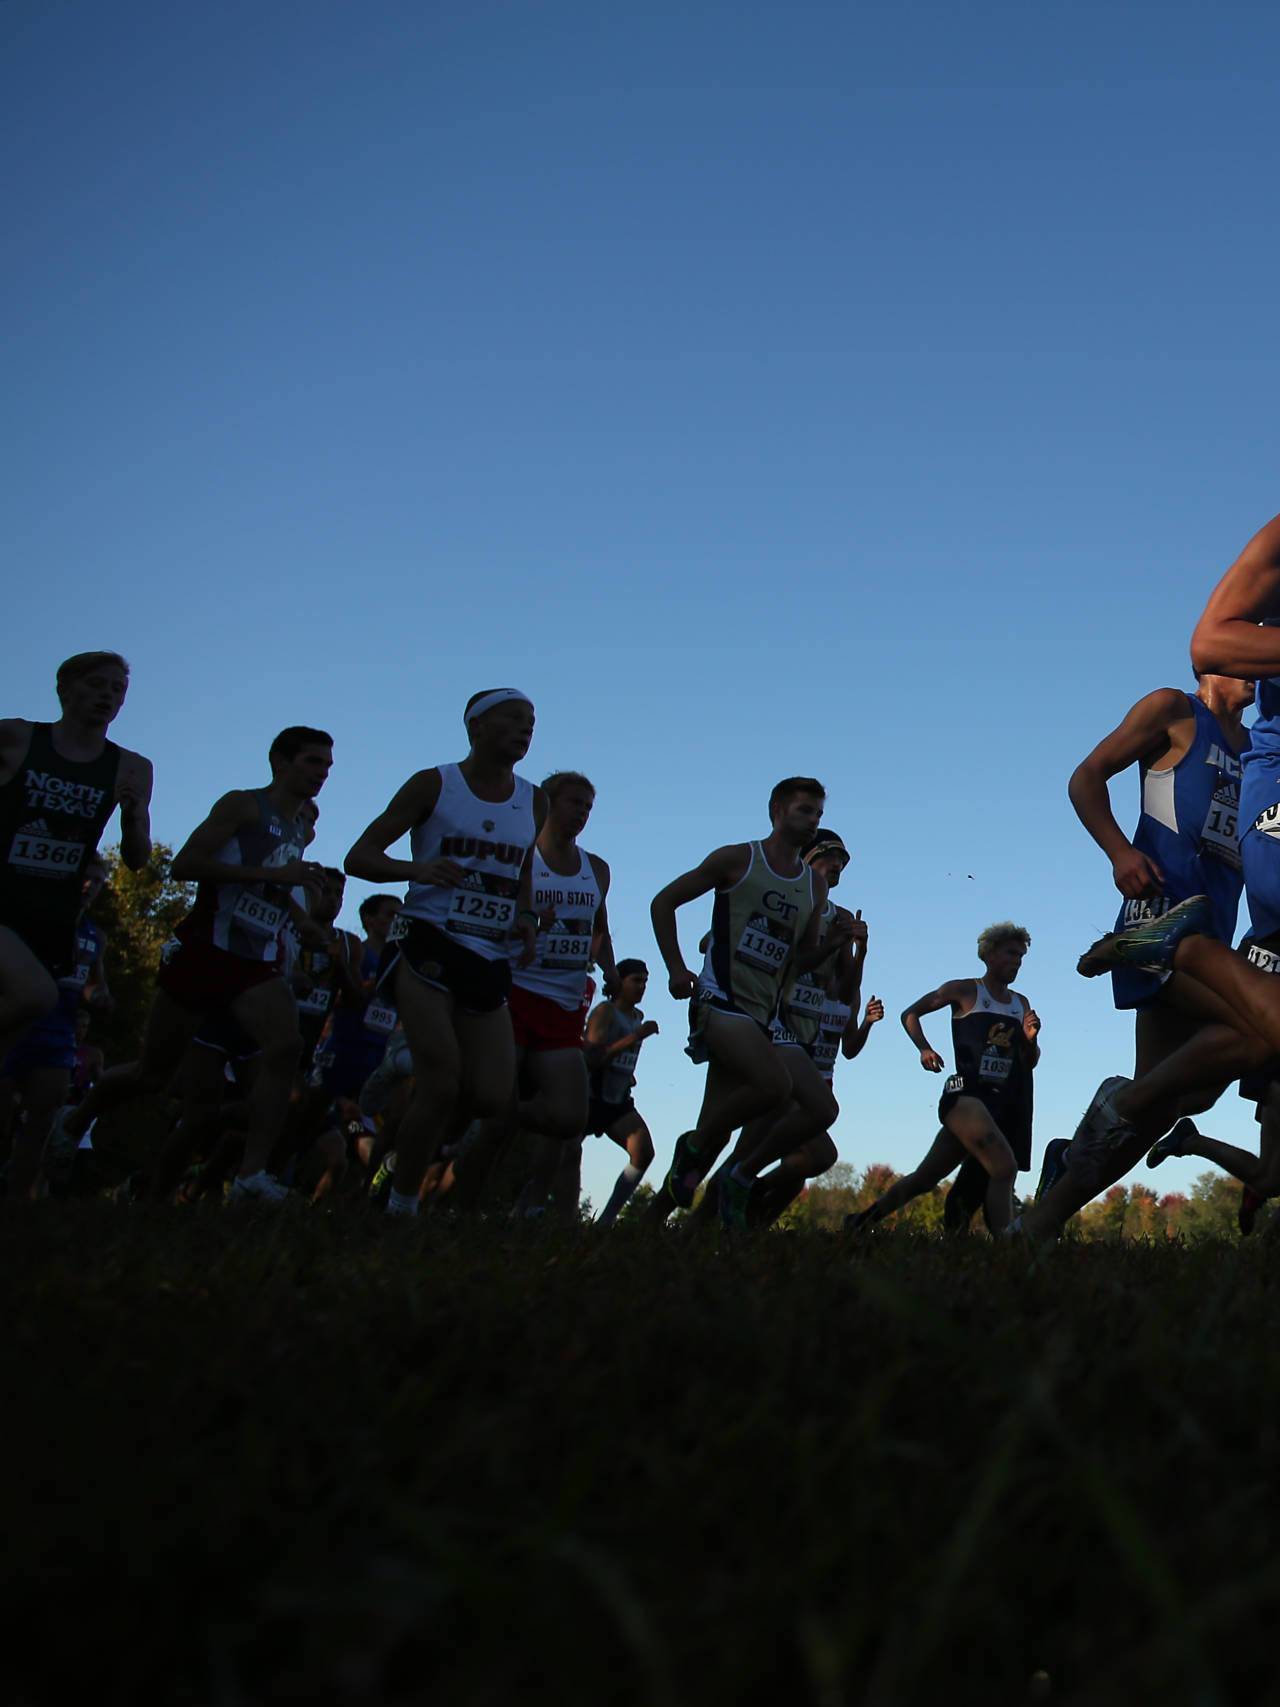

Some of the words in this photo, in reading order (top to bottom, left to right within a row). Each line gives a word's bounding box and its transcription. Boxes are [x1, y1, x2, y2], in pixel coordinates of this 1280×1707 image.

[1205, 744, 1243, 779] UC
[24, 769, 104, 805] NORTH
[27, 789, 97, 819] TEXAS
[1208, 811, 1240, 841] 15
[14, 840, 81, 865] 1366
[440, 836, 525, 867] IUPUI
[453, 895, 511, 922] 1253
[535, 890, 564, 905] OHIO
[567, 892, 595, 908] STATE
[762, 890, 799, 921] GT
[240, 901, 279, 927] 1619
[550, 940, 589, 956] 1381
[742, 933, 786, 962] 1198
